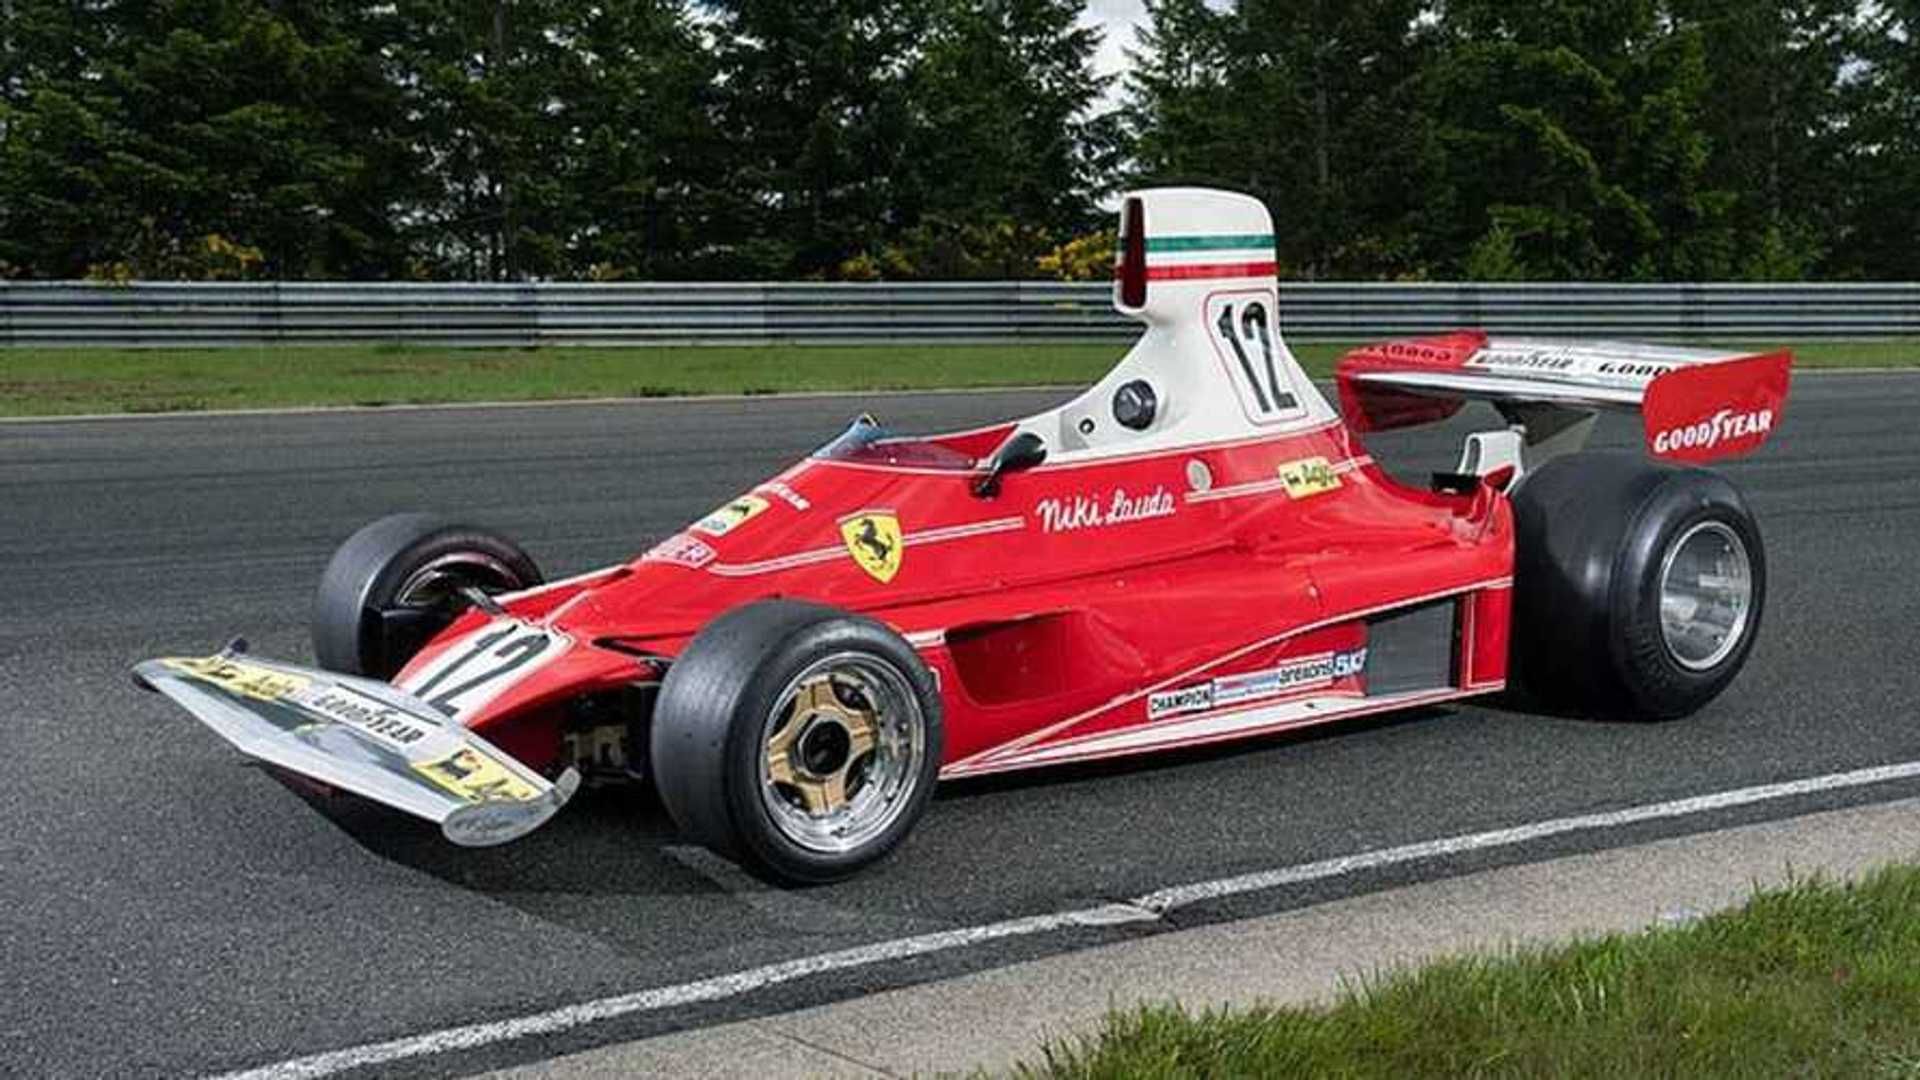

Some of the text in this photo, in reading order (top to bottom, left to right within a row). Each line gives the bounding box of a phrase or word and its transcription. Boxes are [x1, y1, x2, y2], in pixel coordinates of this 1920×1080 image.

[1217, 301, 1298, 413] 12
[1653, 409, 1773, 454] GOODYEAR
[1037, 486, 1176, 532] Niki Lauda
[414, 624, 551, 717] 12
[313, 694, 425, 743] GOODYEAR
[1151, 690, 1210, 714] CHAMPION
